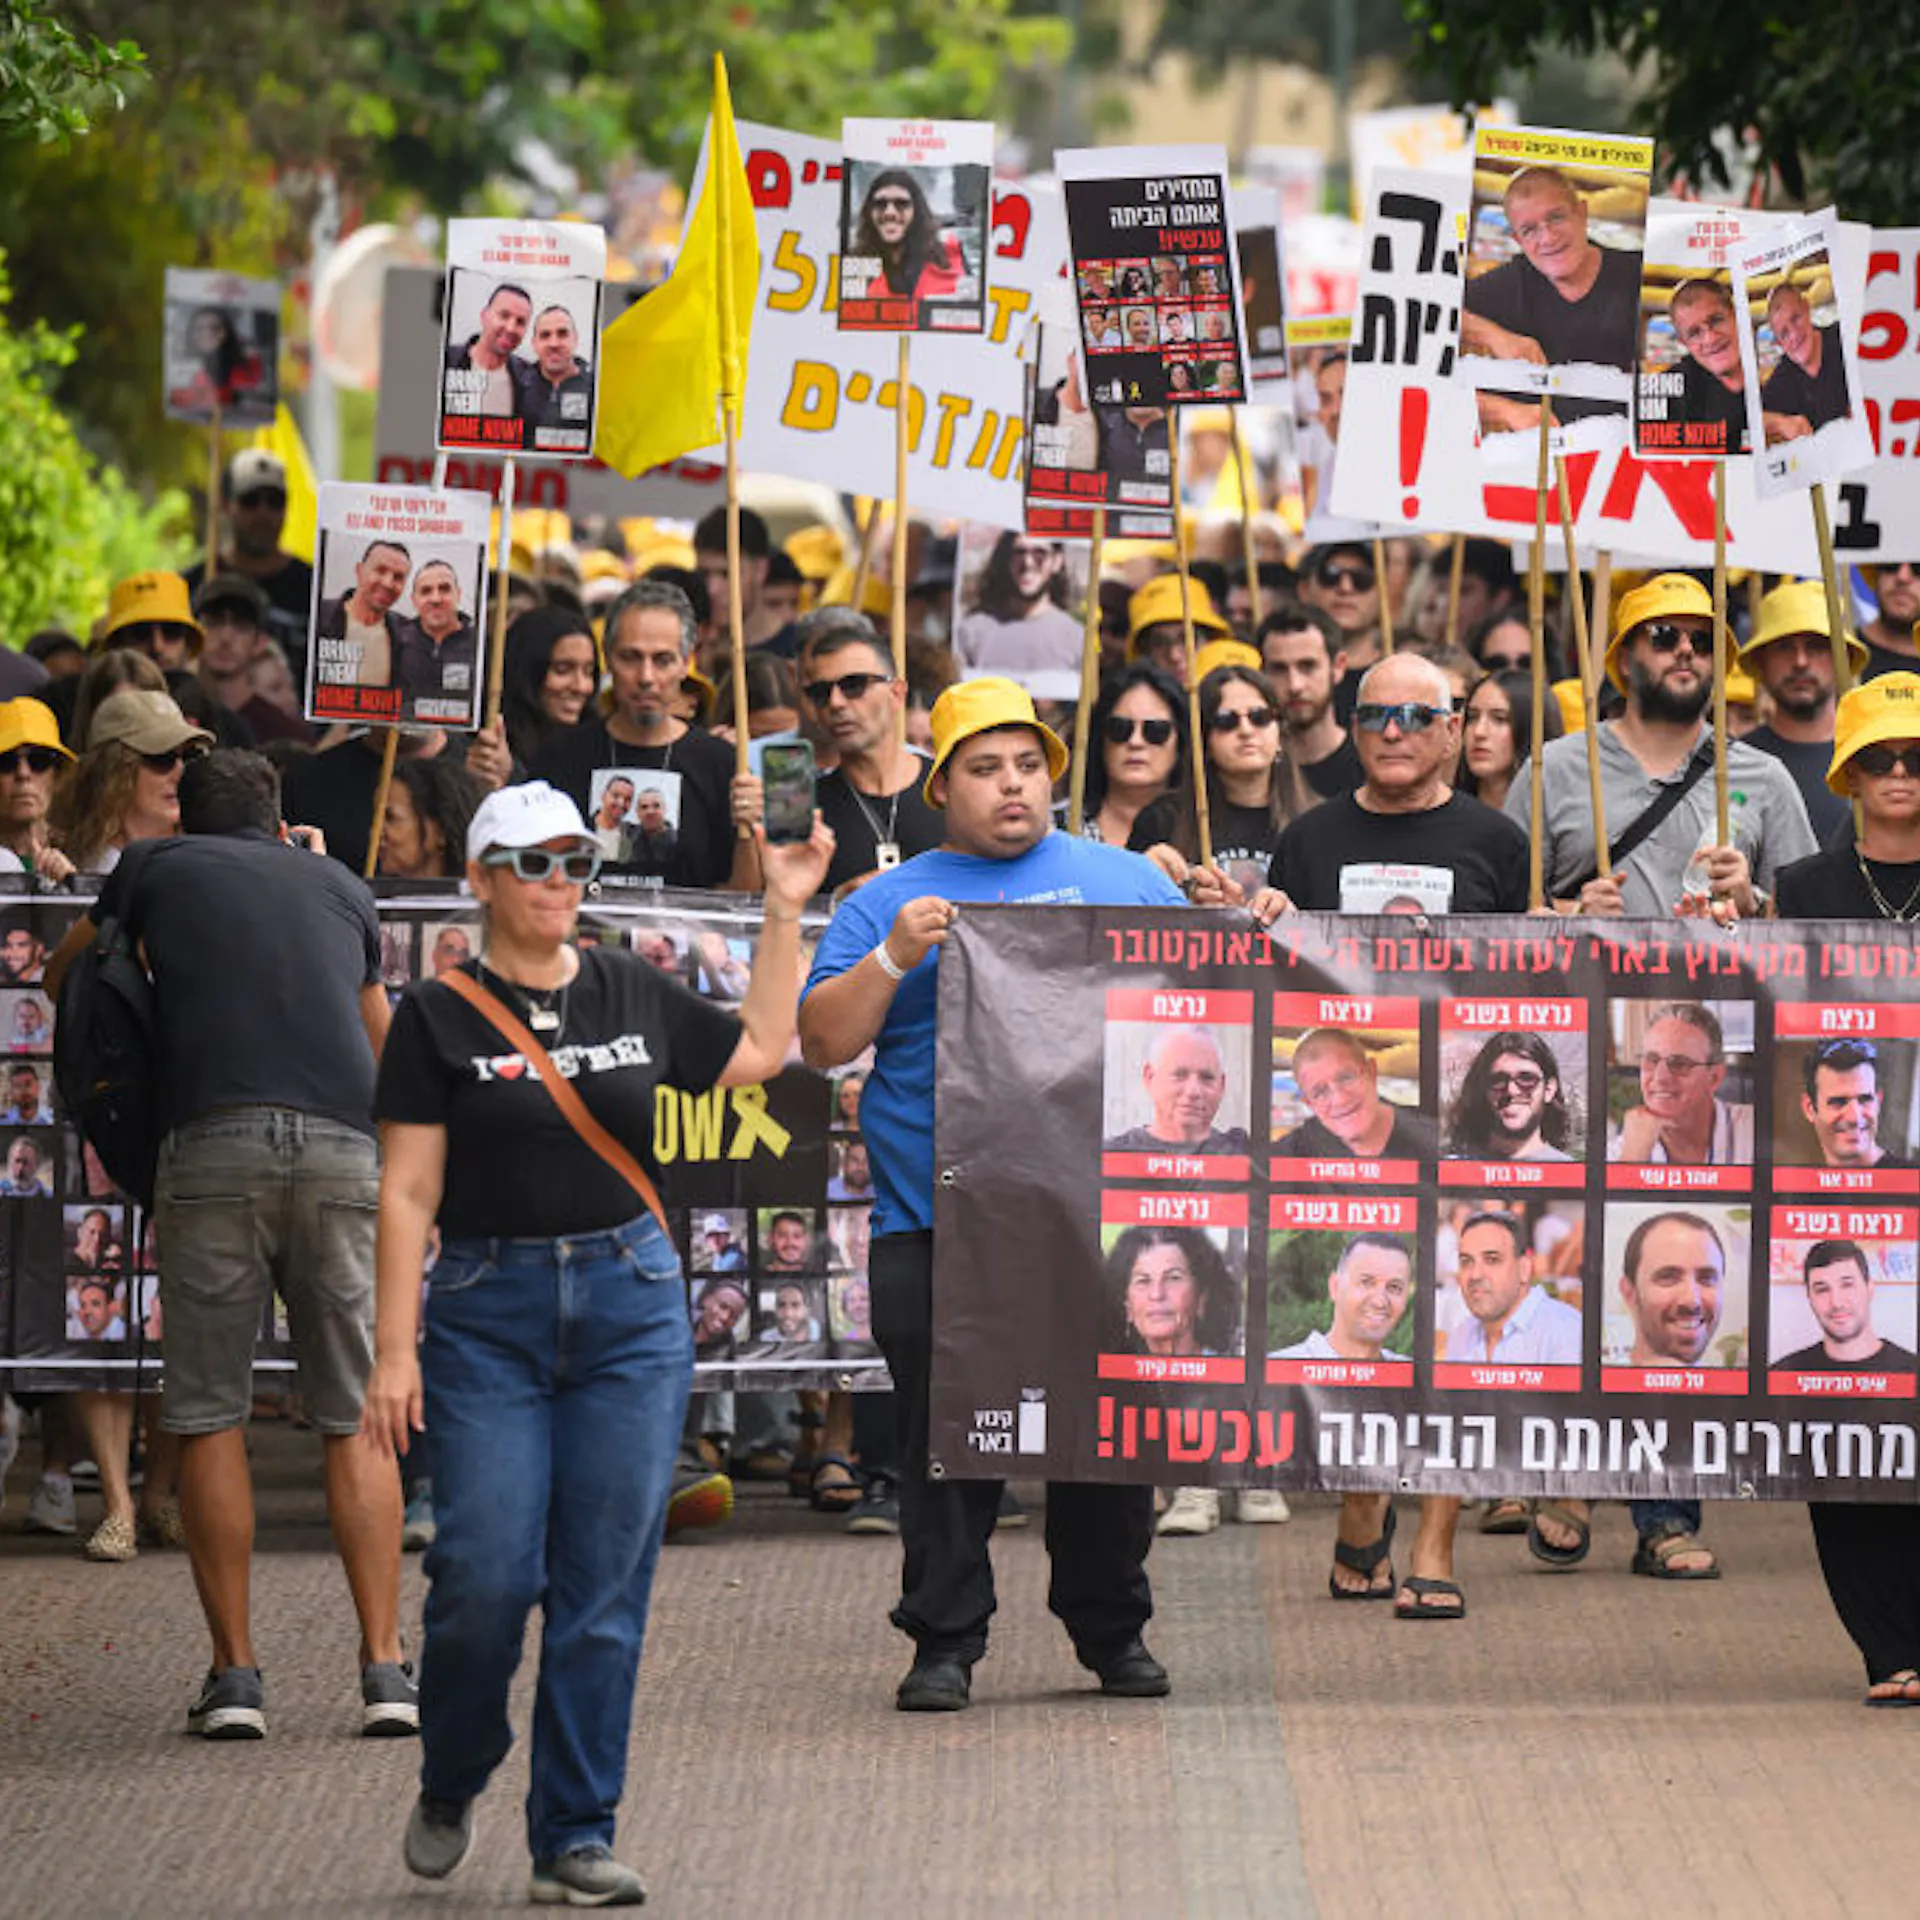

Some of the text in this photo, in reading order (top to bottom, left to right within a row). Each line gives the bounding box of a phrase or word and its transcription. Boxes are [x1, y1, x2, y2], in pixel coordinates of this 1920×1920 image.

[1144, 178, 1218, 201] מחזירים
[1108, 203, 1221, 229] אותם הביתה
[1640, 373, 1685, 395] BRING
[1639, 398, 1668, 420] HIM
[1639, 422, 1682, 446] HOME
[1105, 929, 1275, 971] באוקטובר
[1374, 937, 1474, 972] בשבת
[1487, 932, 1577, 973] לעזה
[1590, 938, 1671, 975] בארי
[1684, 941, 1806, 983] מקיבוץ
[1153, 994, 1206, 1017] נרצח
[1320, 999, 1373, 1022] נרצח
[1454, 1002, 1572, 1026] נרצח בשבי
[1821, 1008, 1876, 1031] נרצח
[653, 1083, 723, 1164] OW
[1139, 1196, 1210, 1221] נרצחה
[1285, 1200, 1401, 1225] נרצח בשבי
[1786, 1211, 1904, 1236] נרצח בשבי
[967, 1431, 1013, 1453] בארי
[1097, 1396, 1917, 1479] מחזירים אותם הביתה עכשיו!
